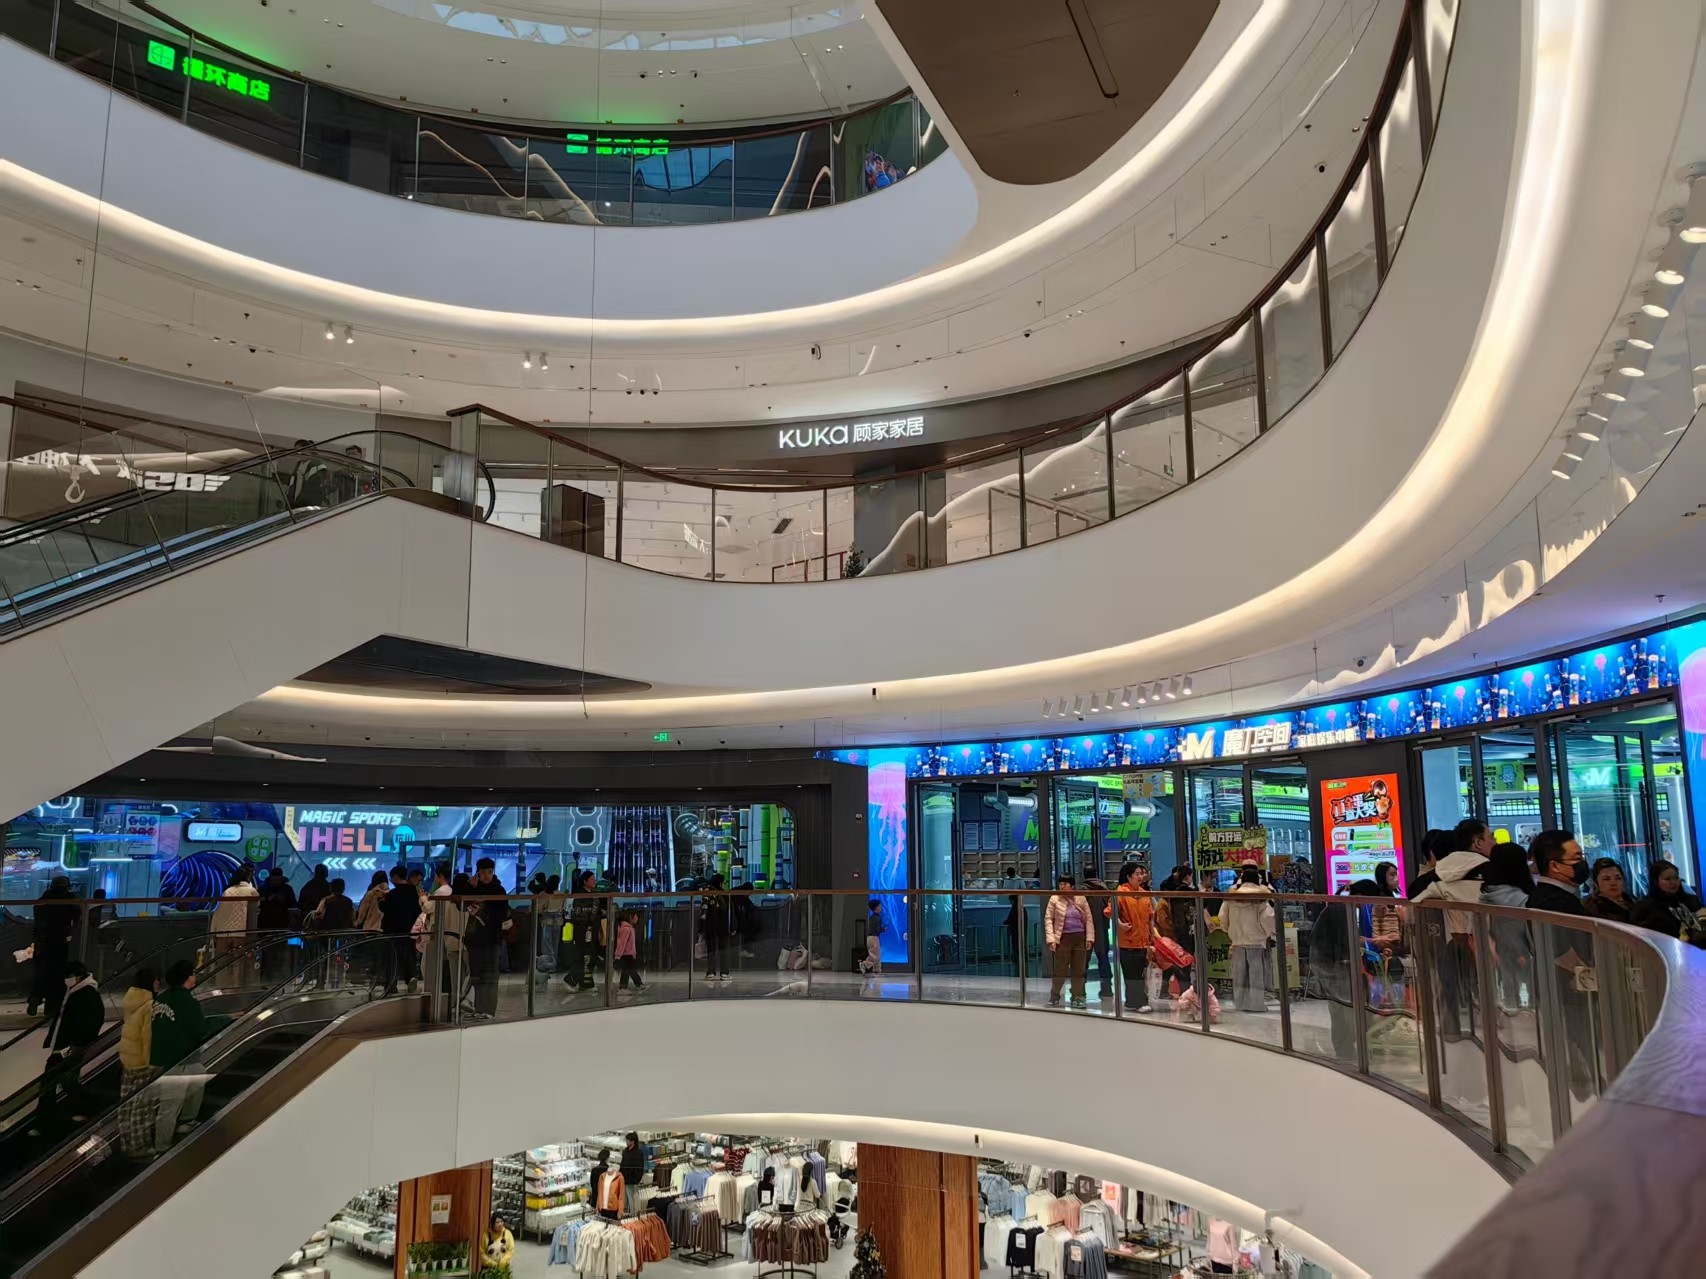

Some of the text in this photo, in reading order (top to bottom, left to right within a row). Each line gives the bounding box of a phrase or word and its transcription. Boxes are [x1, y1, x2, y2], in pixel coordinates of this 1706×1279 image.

[852, 416, 924, 443] 顾家家居
[300, 810, 403, 825] MAGIC SPORTS
